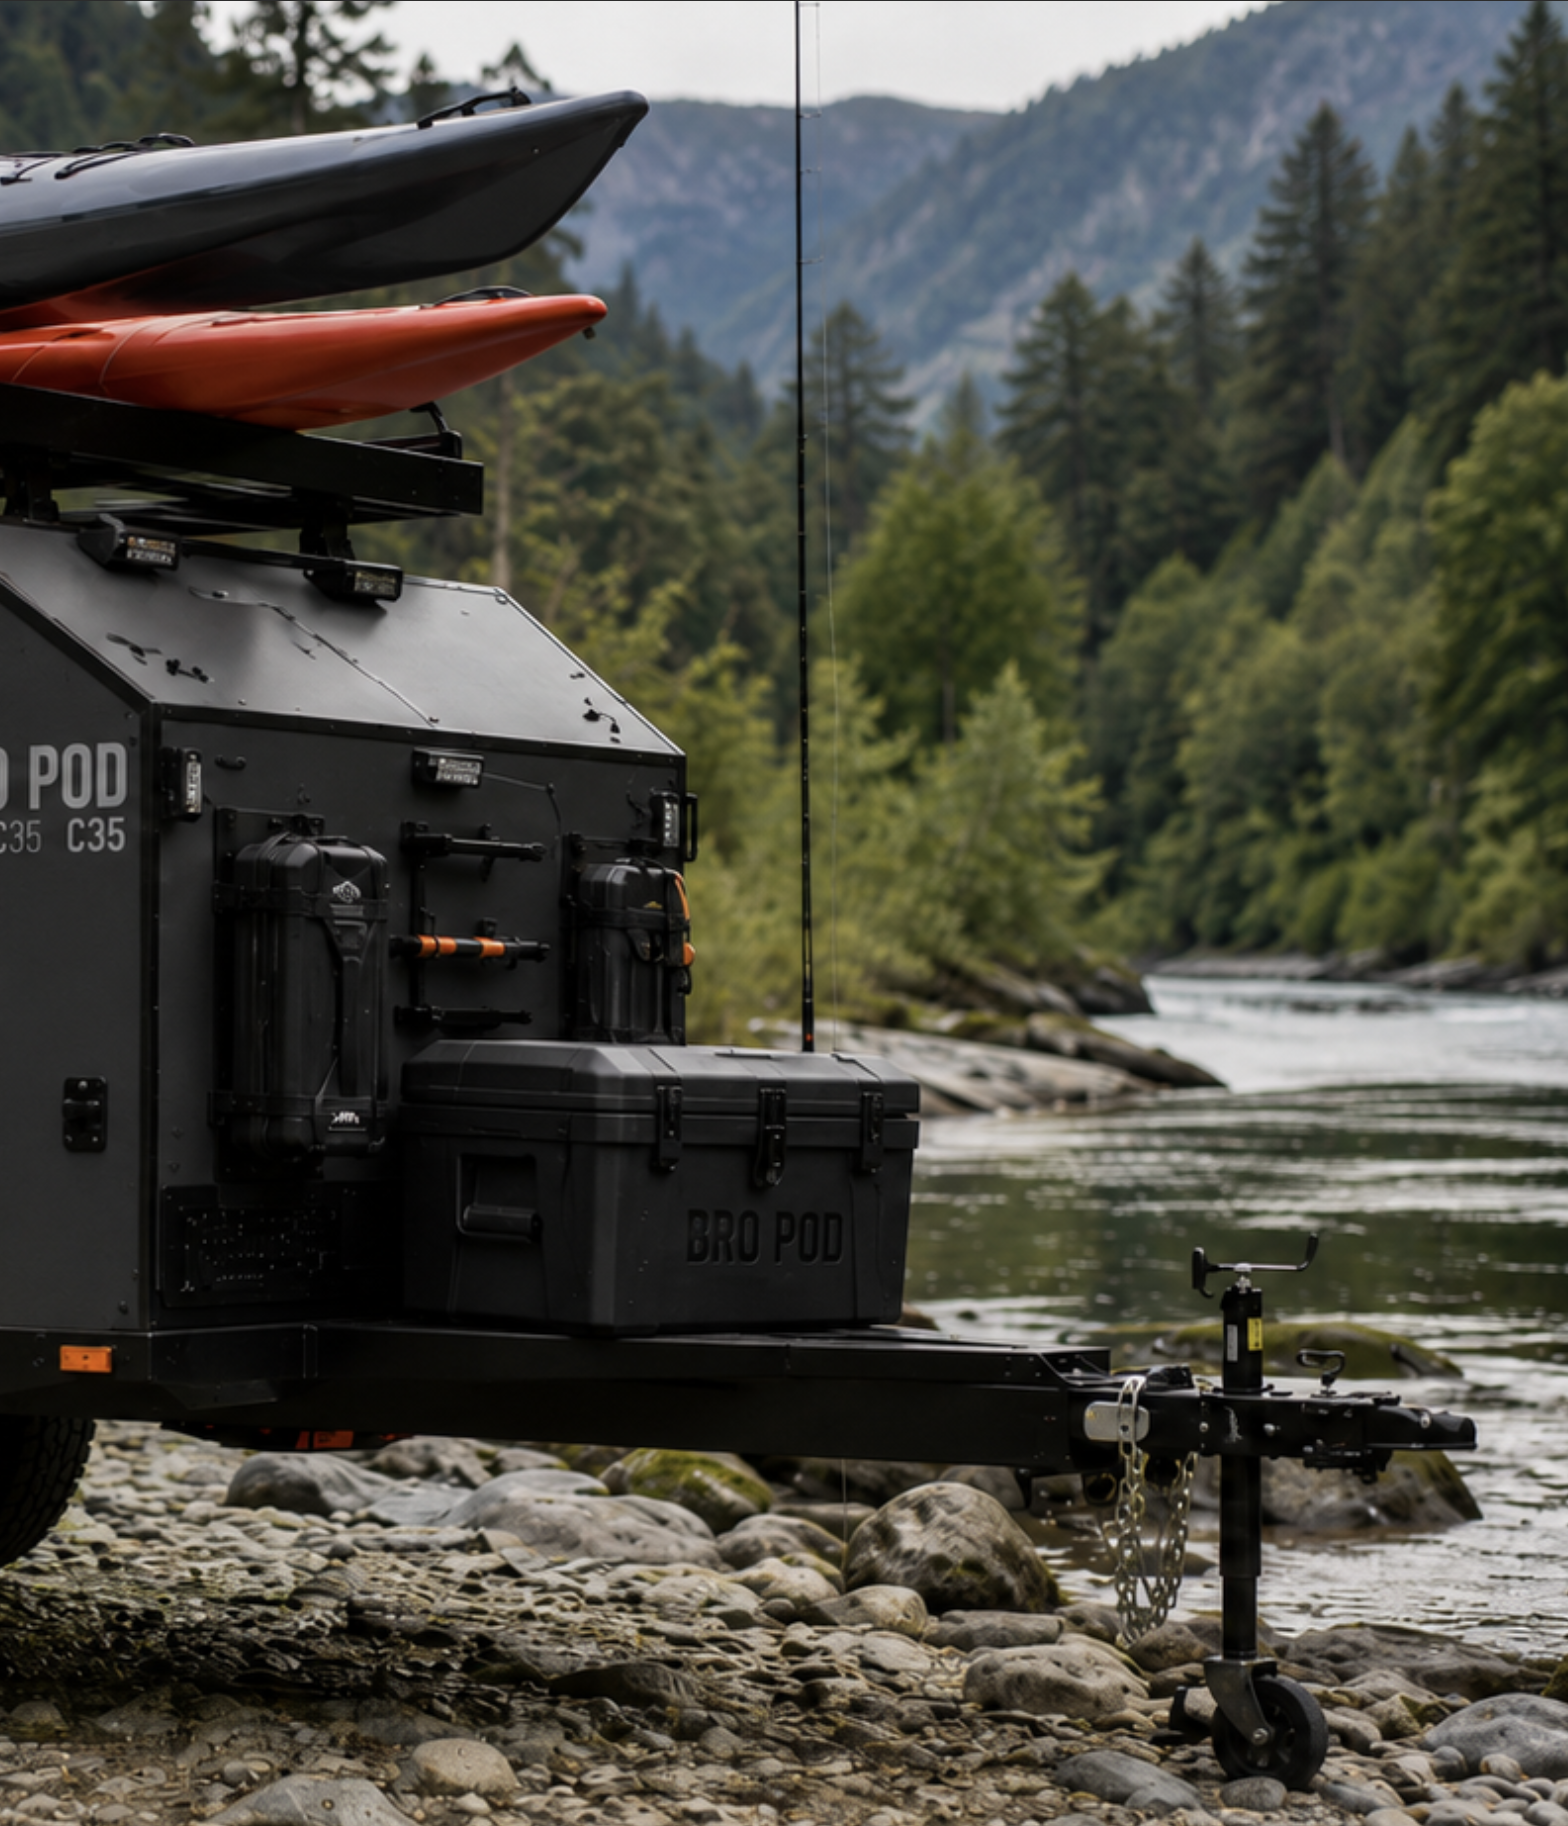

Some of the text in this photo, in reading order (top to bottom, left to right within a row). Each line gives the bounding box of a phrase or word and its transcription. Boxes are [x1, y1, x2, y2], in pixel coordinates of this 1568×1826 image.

[29, 742, 128, 810] POD
[67, 817, 125, 852] C35
[686, 1209, 844, 1266] BRO POD
